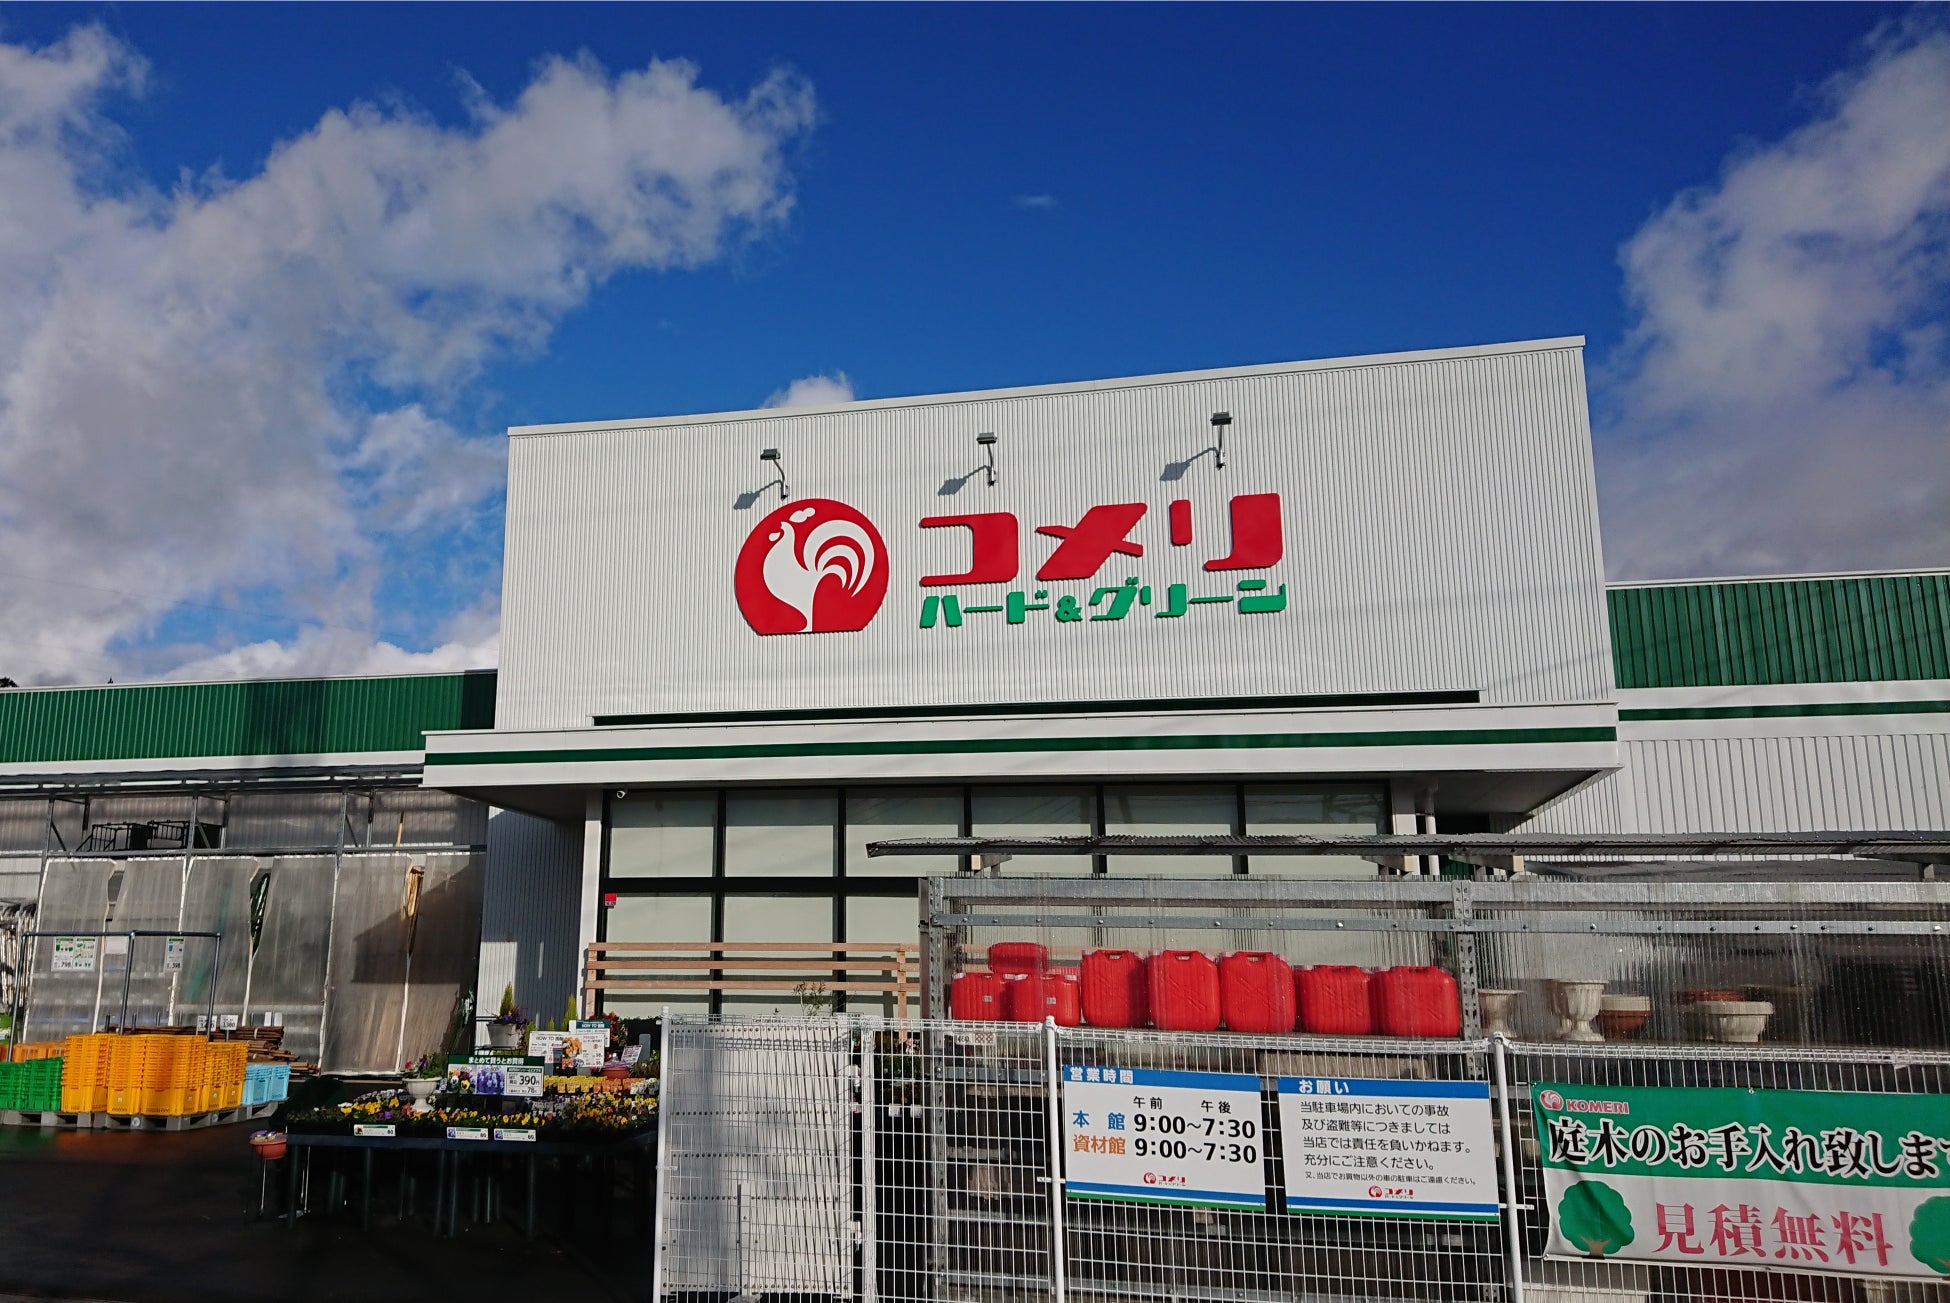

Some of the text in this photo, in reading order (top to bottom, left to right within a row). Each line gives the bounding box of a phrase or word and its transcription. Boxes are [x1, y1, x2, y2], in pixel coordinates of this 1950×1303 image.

[919, 492, 1284, 587] コメリ
[919, 577, 1287, 628] ハード&グリーン
[1070, 1066, 1134, 1084] 営業時間
[1298, 1079, 1349, 1095] お願い
[1133, 1096, 1231, 1114] 午前 午後
[1300, 1101, 1449, 1117] 当駐車場内においての事故
[1566, 1099, 1629, 1114] KOMERI
[1301, 1118, 1451, 1134] 及び盗難等につきましては
[1073, 1134, 1126, 1155] 資材館
[1303, 1136, 1471, 1154] 当店では責任を負いかねます。
[1304, 1154, 1434, 1171] 充分にご注意ください。
[1651, 1202, 1893, 1267] 見積無料
